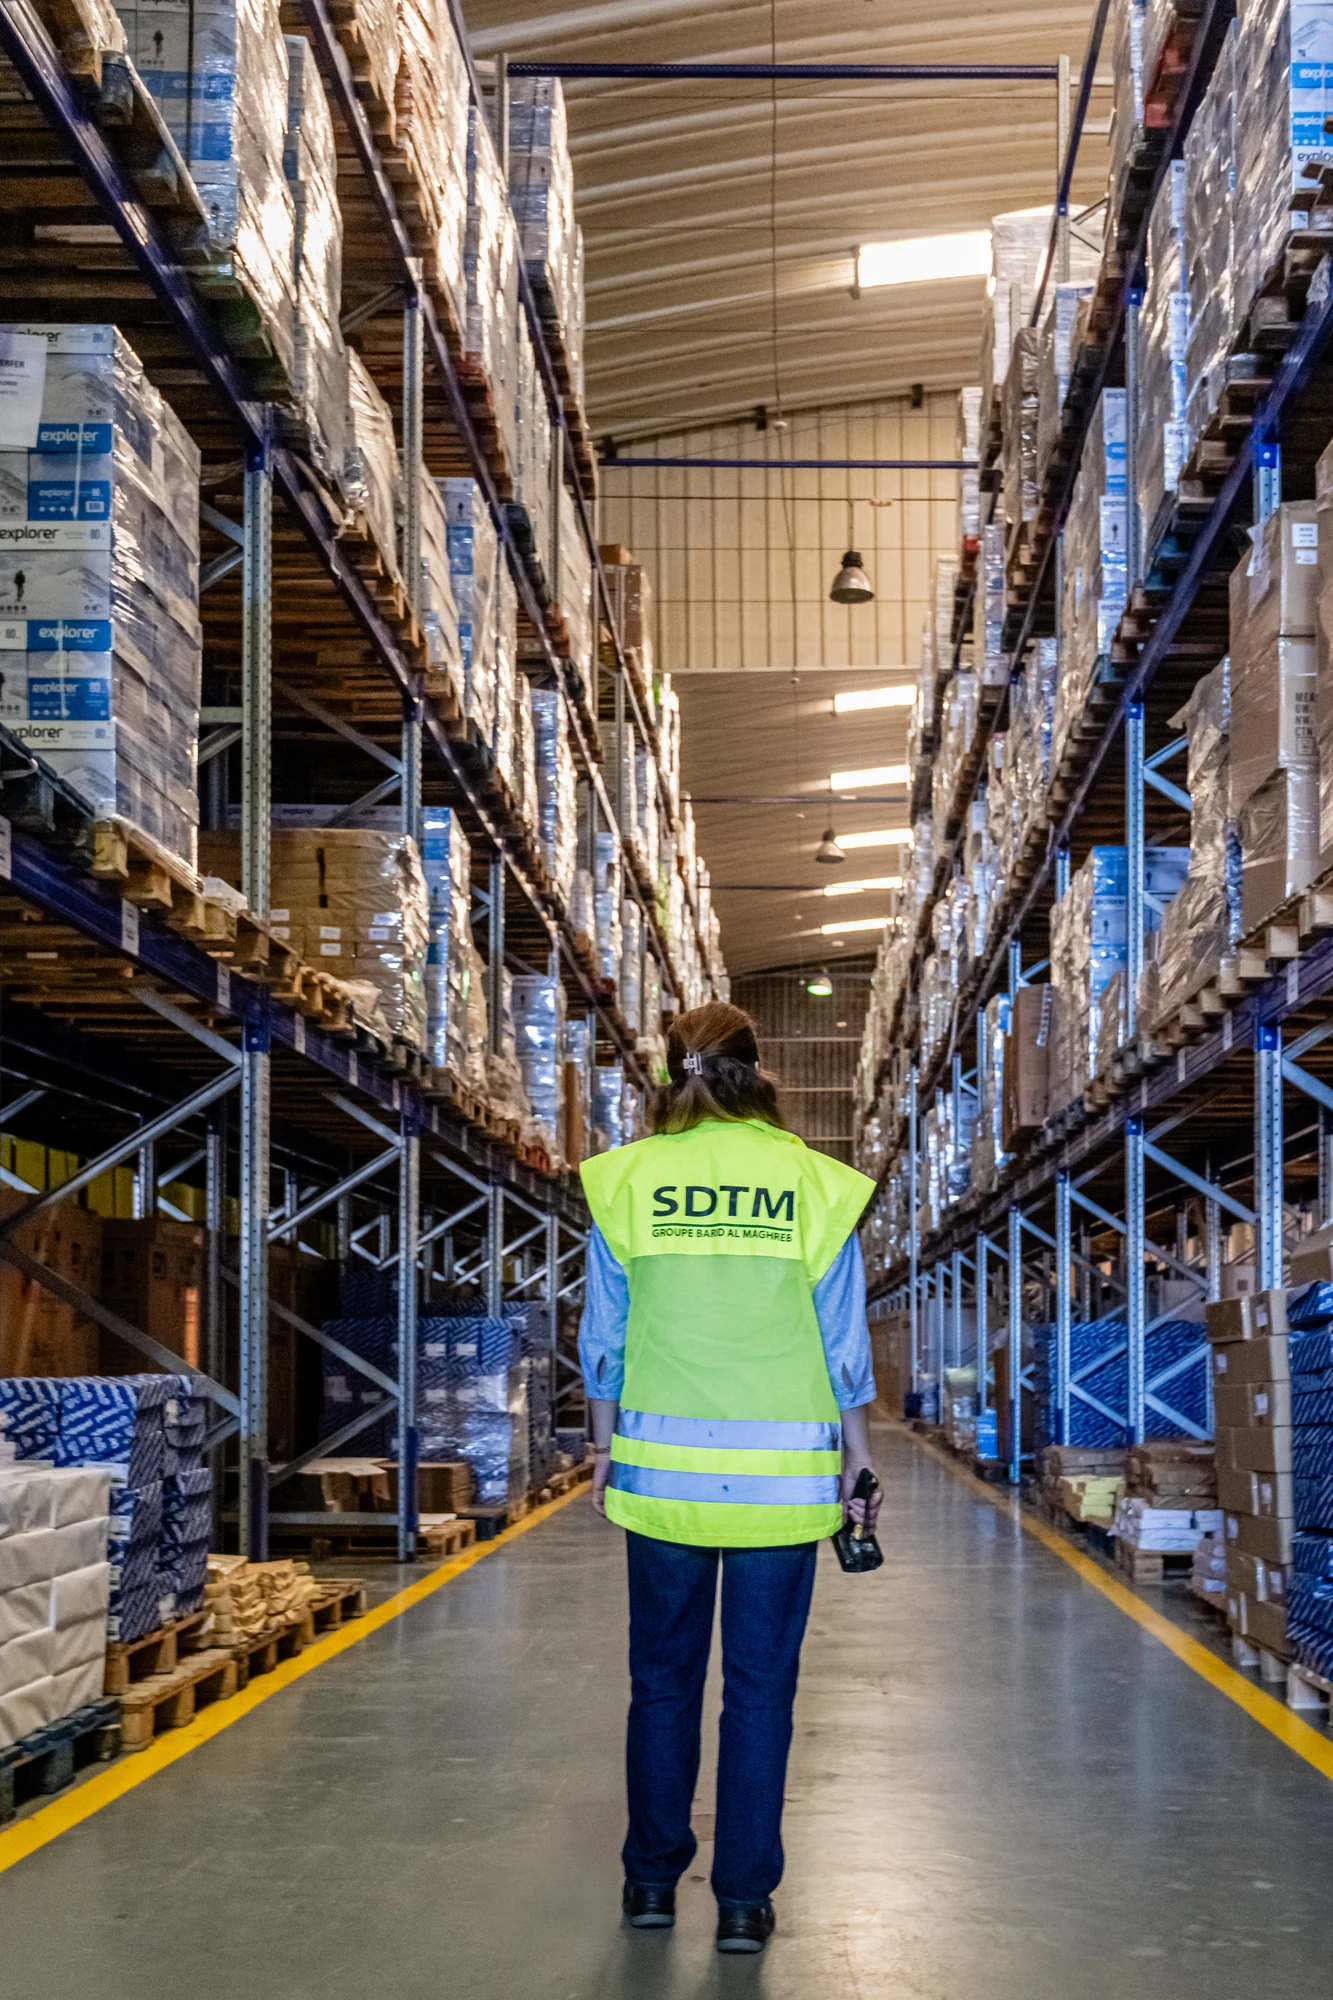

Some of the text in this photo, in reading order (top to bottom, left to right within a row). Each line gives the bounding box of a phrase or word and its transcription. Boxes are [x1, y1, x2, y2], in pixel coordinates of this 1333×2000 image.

[40, 428, 99, 445] explorer
[0, 525, 60, 543] explorer
[39, 625, 99, 641] explorer
[11, 724, 64, 740] xplorer
[652, 1185, 794, 1222] SDTM
[652, 1227, 793, 1242] GROUPE BARID AL MAGHREB
